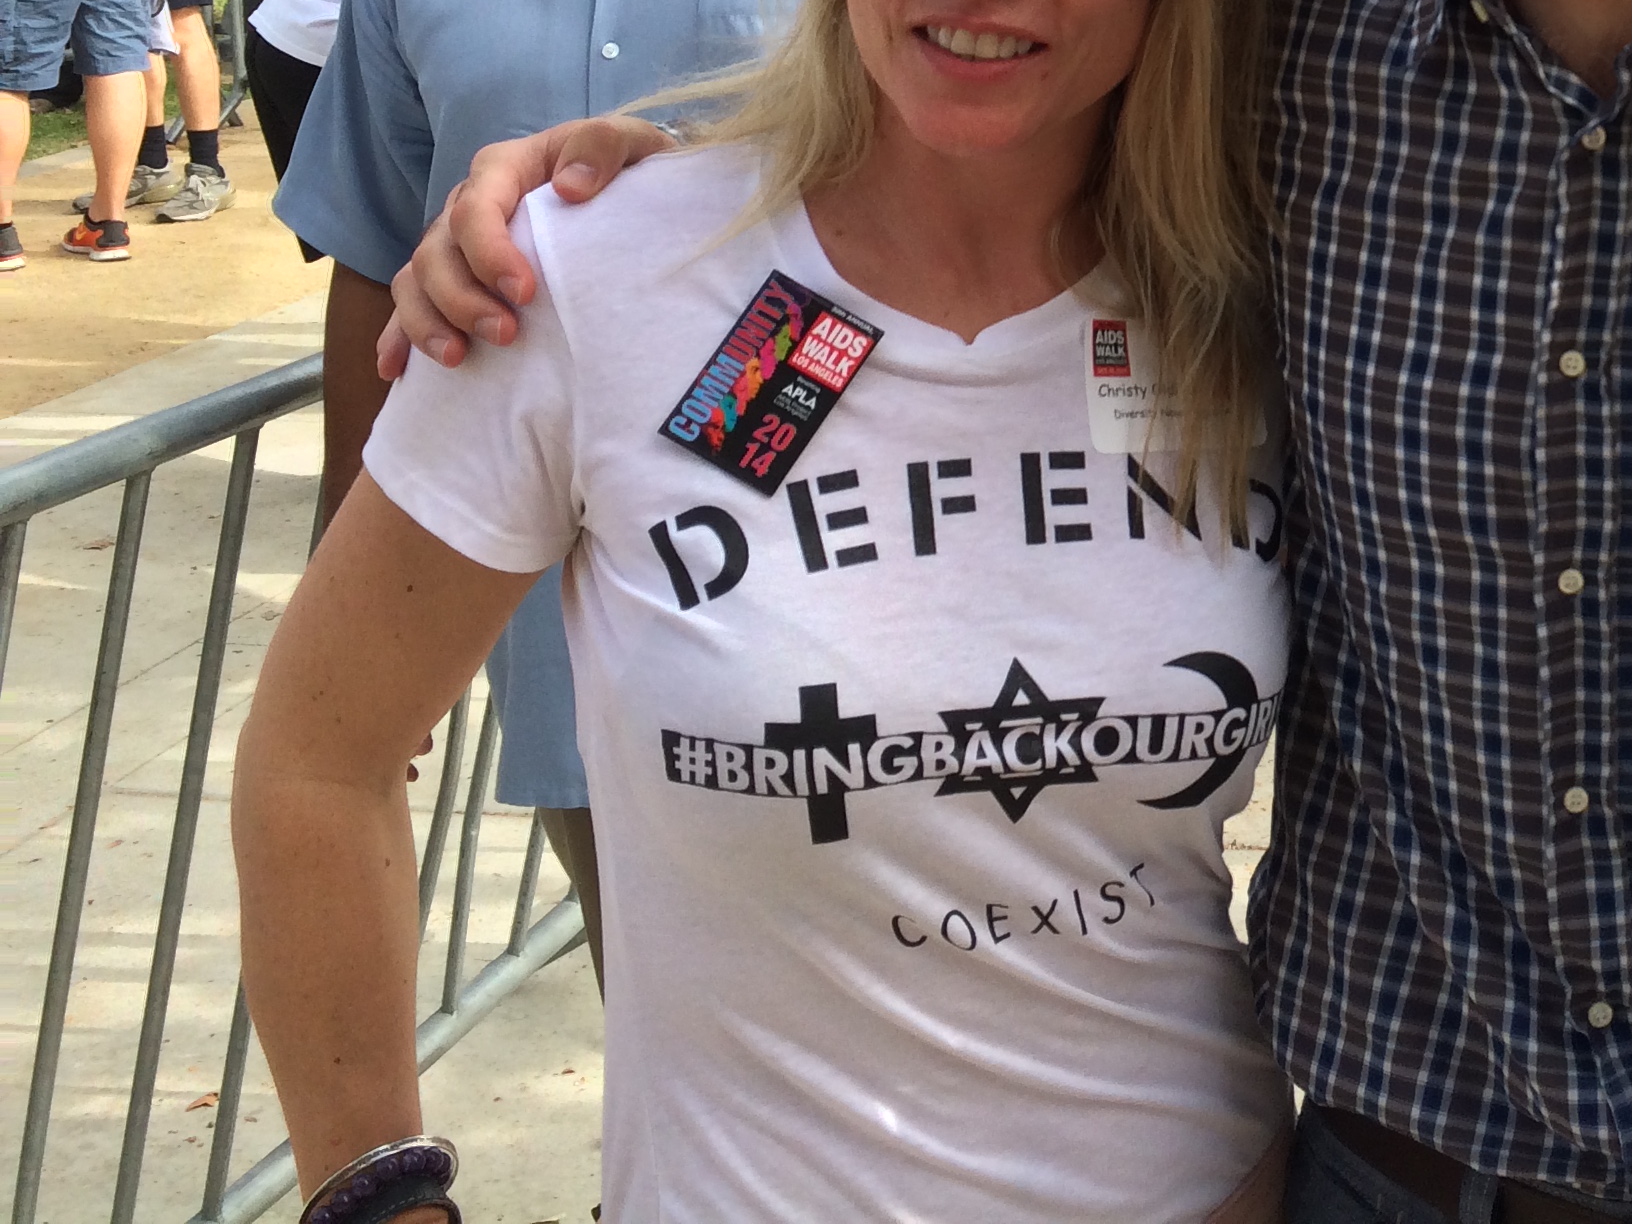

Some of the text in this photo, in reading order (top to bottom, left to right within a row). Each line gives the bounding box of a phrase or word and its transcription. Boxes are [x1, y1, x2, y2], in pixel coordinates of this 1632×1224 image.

[812, 316, 867, 359] AIDS
[1095, 330, 1125, 345] AIDS
[1096, 345, 1126, 357] WALK
[668, 279, 795, 443] COMMUNITY
[792, 353, 810, 369] LOS
[808, 363, 844, 388] ANGELES
[802, 336, 855, 377] WALK
[781, 382, 817, 410] APLA
[1098, 383, 1147, 401] Christy
[752, 414, 796, 452] 20
[738, 442, 777, 478] 14
[891, 863, 1157, 951] COEXIST
